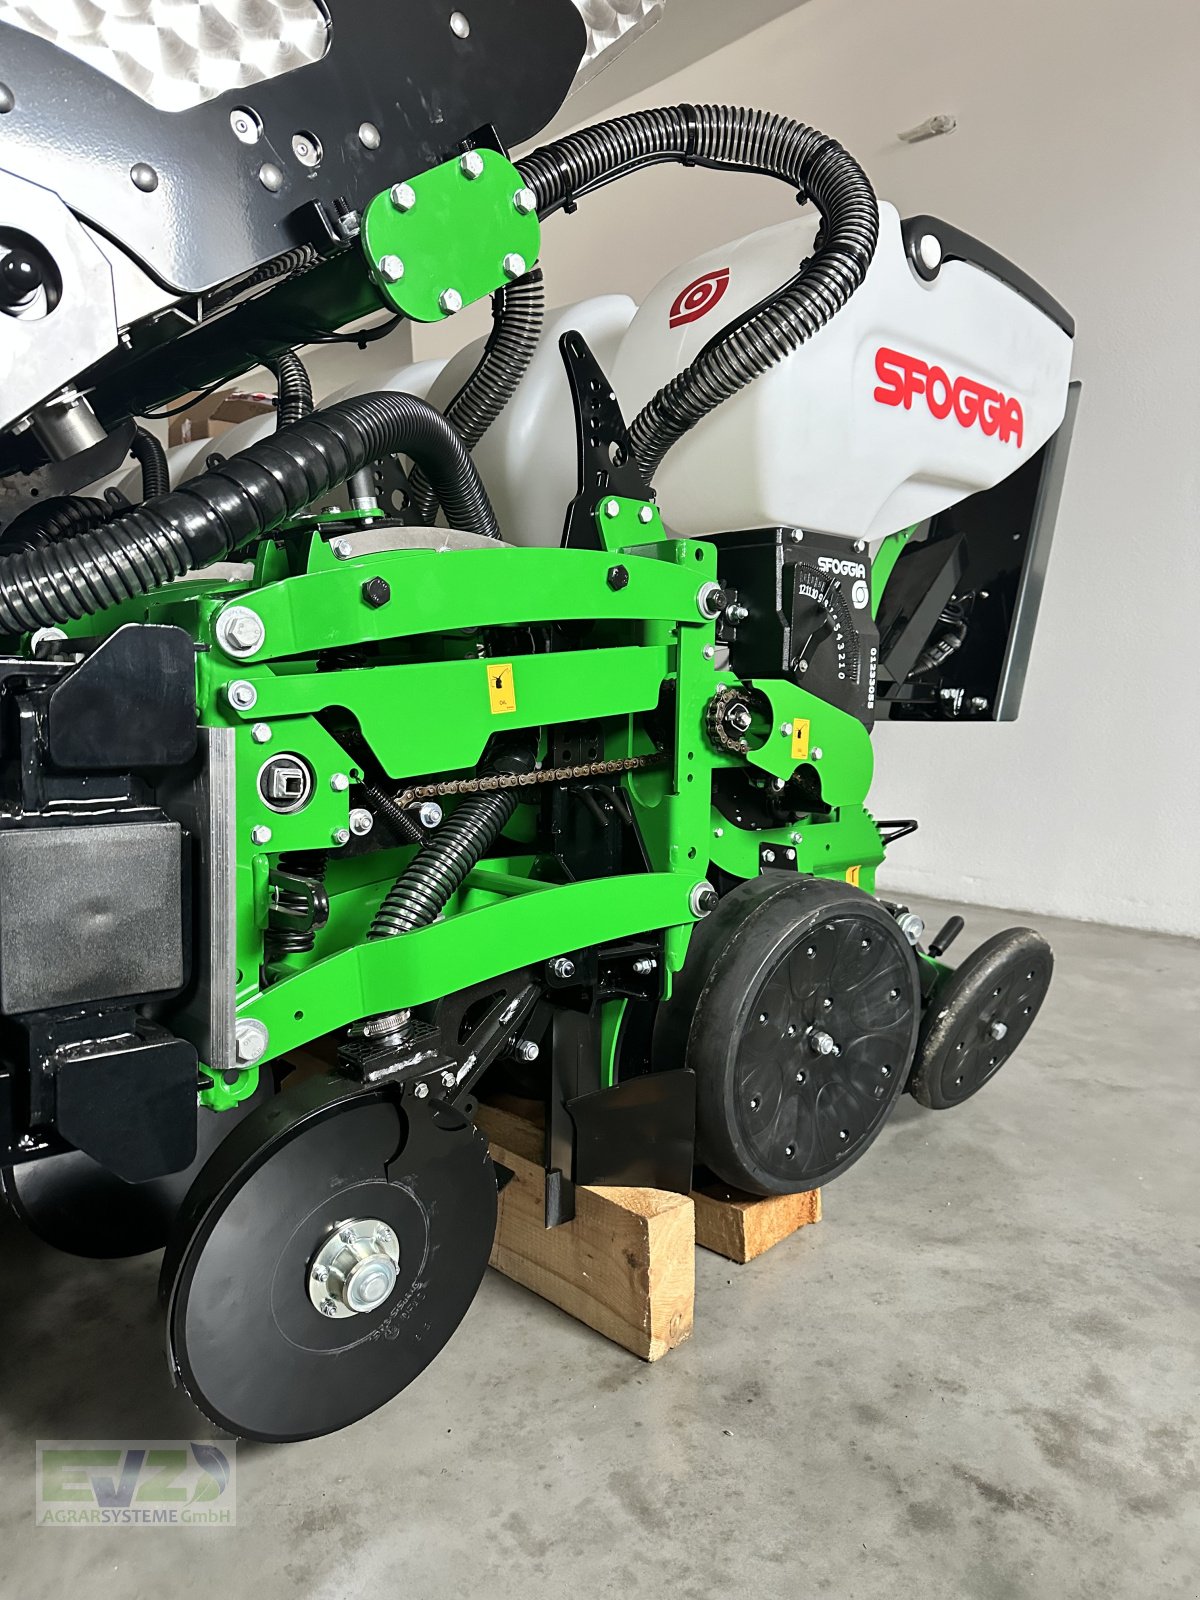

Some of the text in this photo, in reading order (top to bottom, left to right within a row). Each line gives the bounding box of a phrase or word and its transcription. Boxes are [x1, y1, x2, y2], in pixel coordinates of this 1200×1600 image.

[874, 347, 1023, 449] SFOGGIA
[817, 556, 866, 579] SFOGGIA
[836, 633, 843, 641] 4
[837, 642, 845, 651] 3
[838, 653, 846, 661] 2
[838, 672, 846, 680] 0
